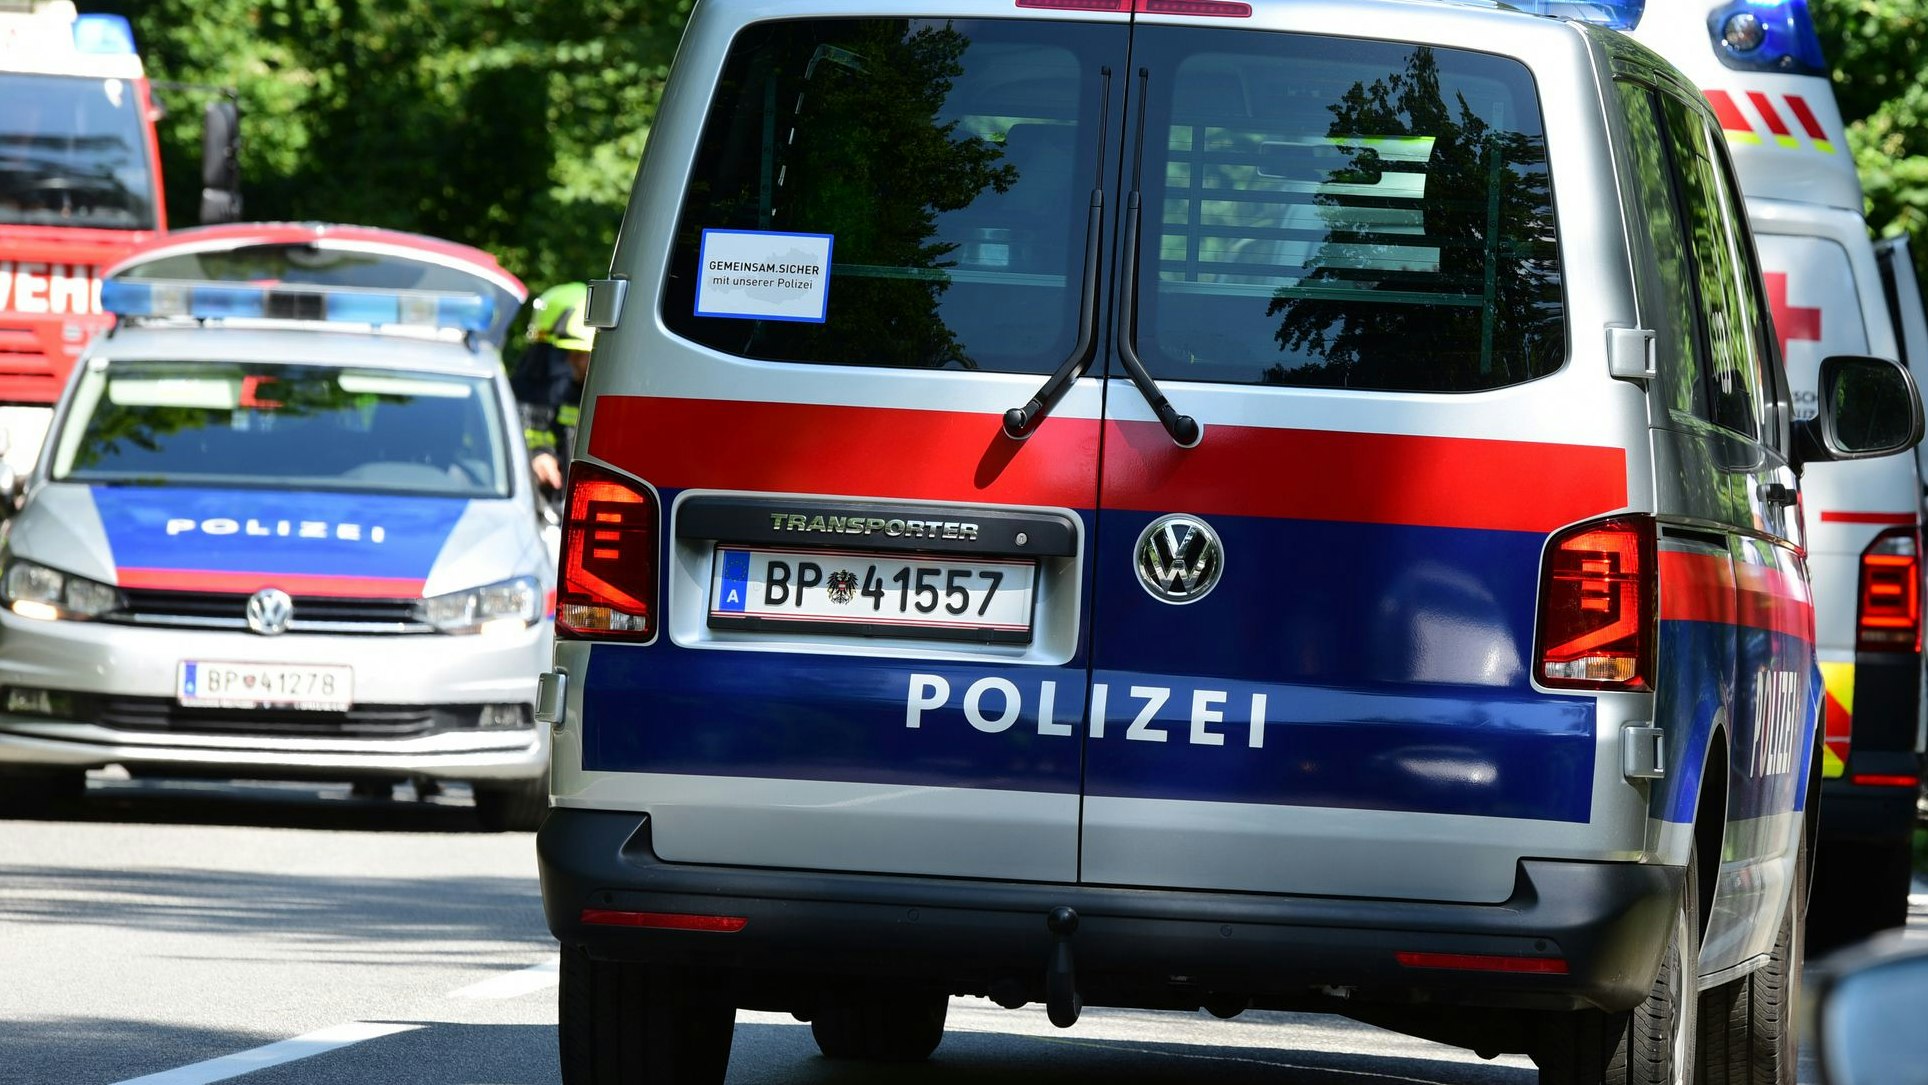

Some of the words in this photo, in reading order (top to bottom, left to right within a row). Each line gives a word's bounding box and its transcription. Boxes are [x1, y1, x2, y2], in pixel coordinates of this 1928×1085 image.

[709, 260, 820, 275] GEMEINSAM.SICHER
[712, 275, 730, 286] mit
[733, 278, 775, 288] unserer
[777, 277, 813, 290] Polizei
[166, 518, 385, 544] POLIZEI
[769, 512, 980, 541] TRANSPORTER
[764, 560, 823, 608] BP
[860, 564, 1004, 617] 41557
[207, 670, 239, 693] BP
[260, 671, 335, 696] 41278
[905, 673, 1268, 749] POLIZEI
[1749, 670, 1797, 779] POLIZEI
